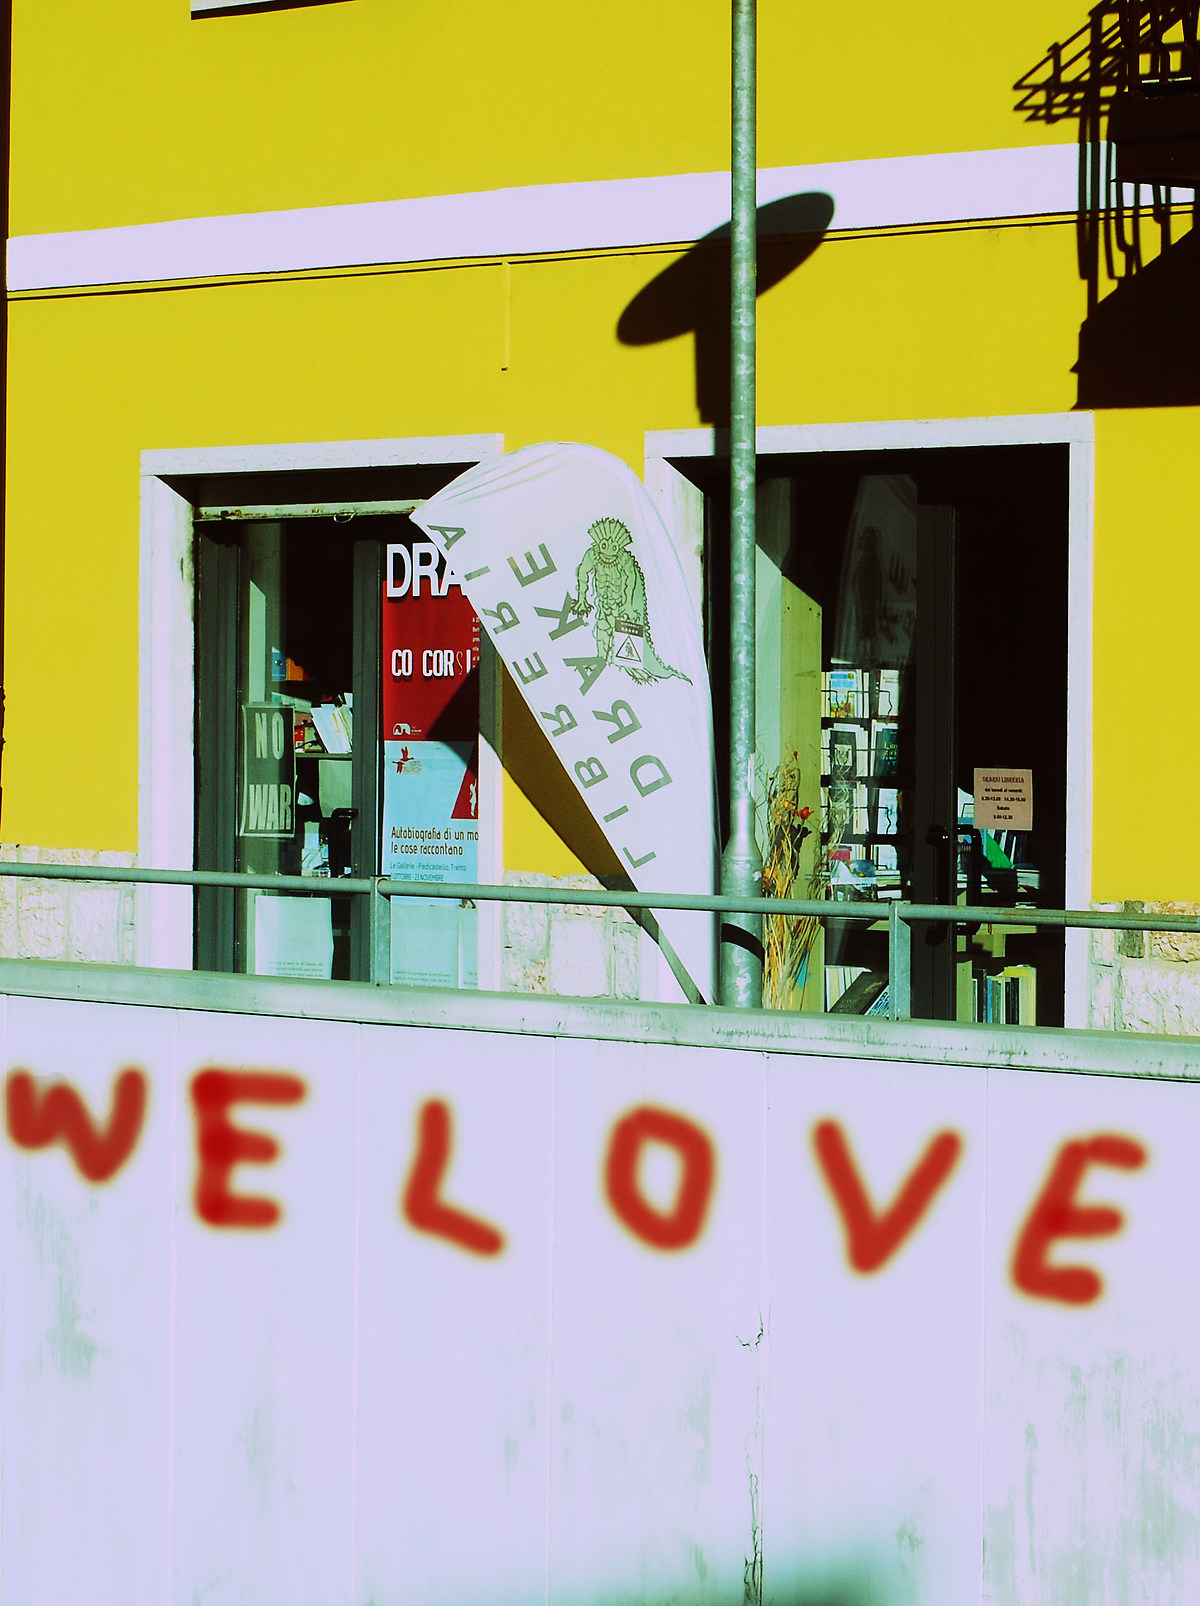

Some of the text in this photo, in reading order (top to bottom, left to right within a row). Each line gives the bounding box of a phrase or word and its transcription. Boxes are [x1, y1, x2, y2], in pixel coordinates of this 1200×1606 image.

[391, 648, 413, 677] CO
[254, 711, 286, 760] NO
[248, 783, 292, 830] WAR
[391, 826, 441, 843] Autobiografia
[443, 827, 452, 840] di
[454, 831, 465, 840] un
[400, 844, 418, 854] cose
[420, 843, 463, 855] raccontano
[450, 864, 467, 872] Trento
[6, 1067, 305, 1228] WE
[404, 1099, 1146, 1305] LOVE
